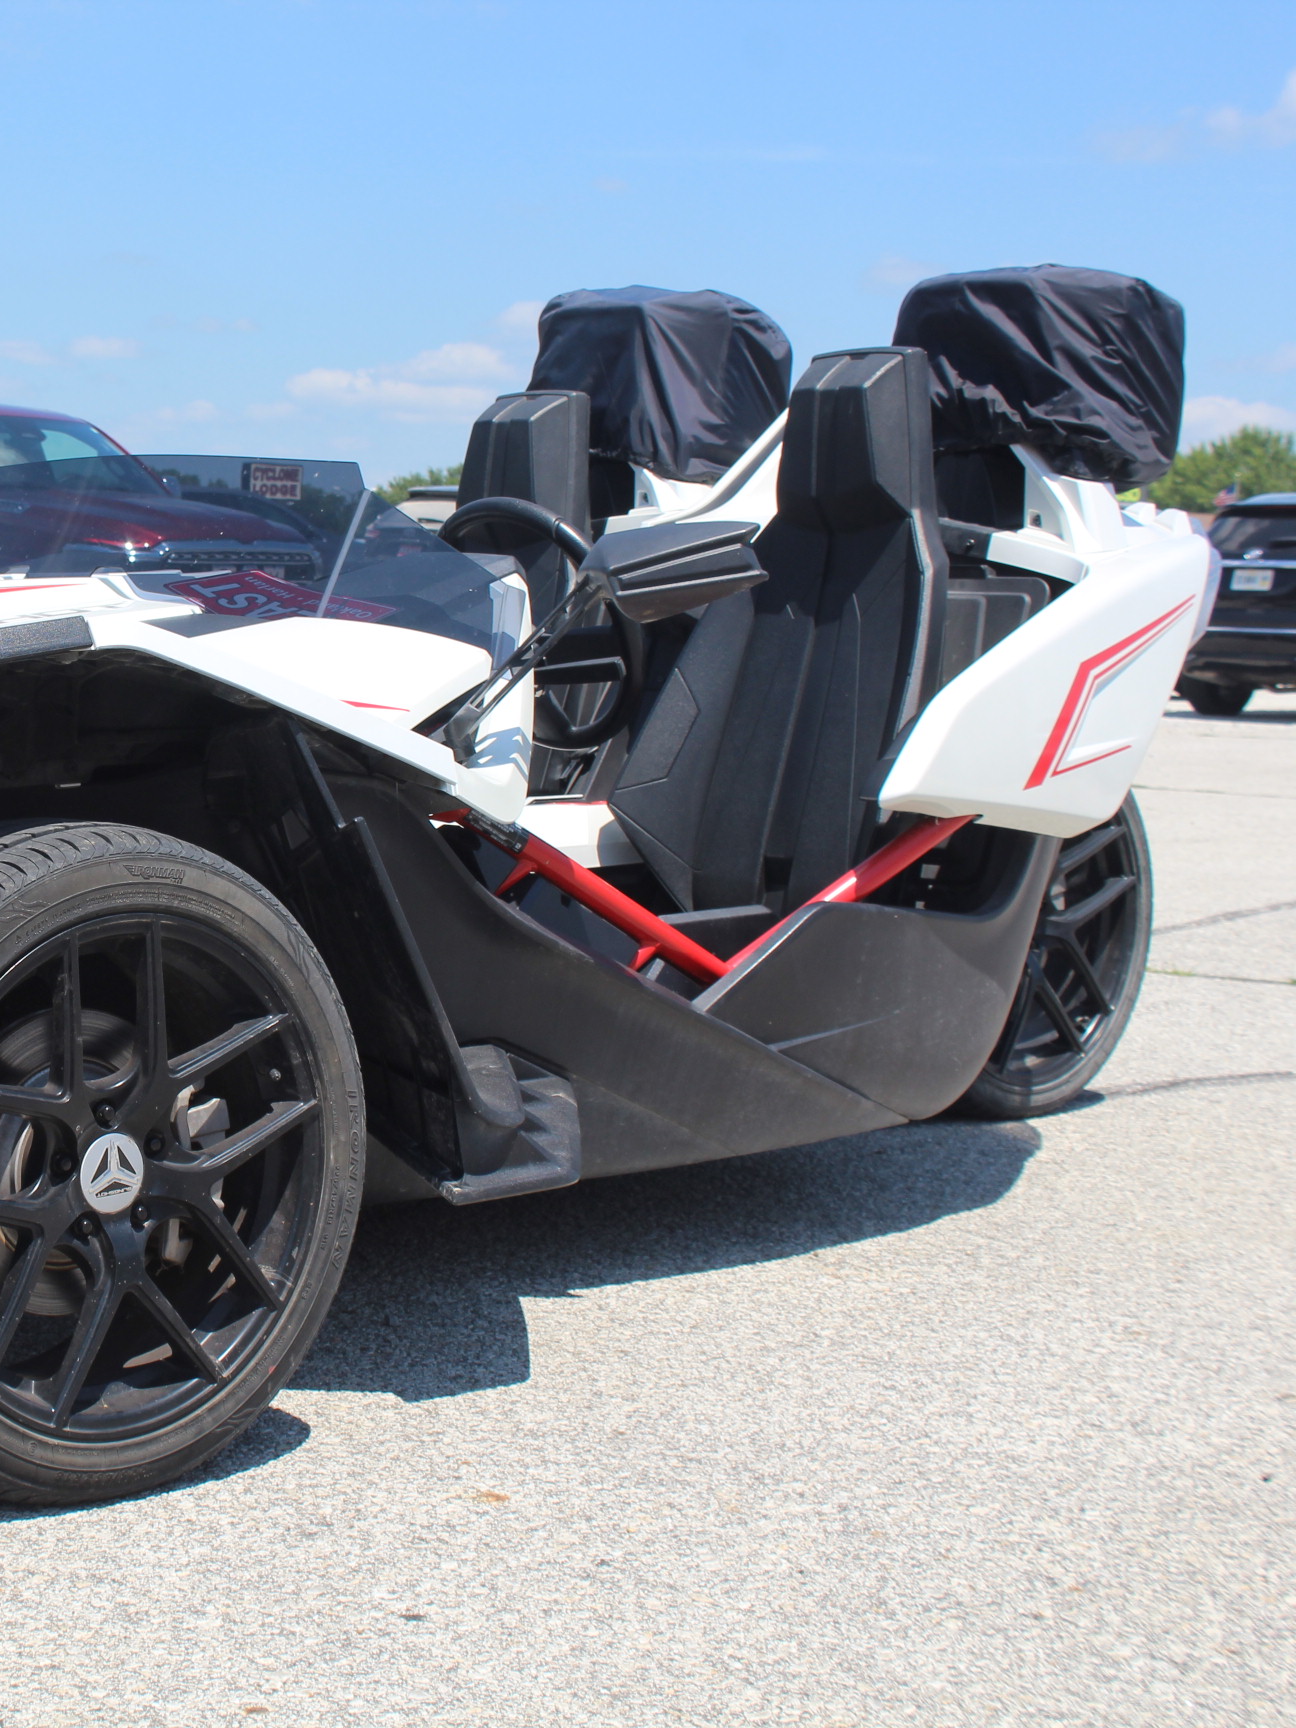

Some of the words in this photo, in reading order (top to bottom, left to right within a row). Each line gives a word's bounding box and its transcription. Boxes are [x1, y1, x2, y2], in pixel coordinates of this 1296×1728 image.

[252, 467, 300, 482] CYCLONE
[252, 483, 299, 497] LODGE
[244, 575, 296, 599] Harlan
[132, 864, 186, 880] IRONMAN
[331, 1090, 360, 1272] IRONMAN
